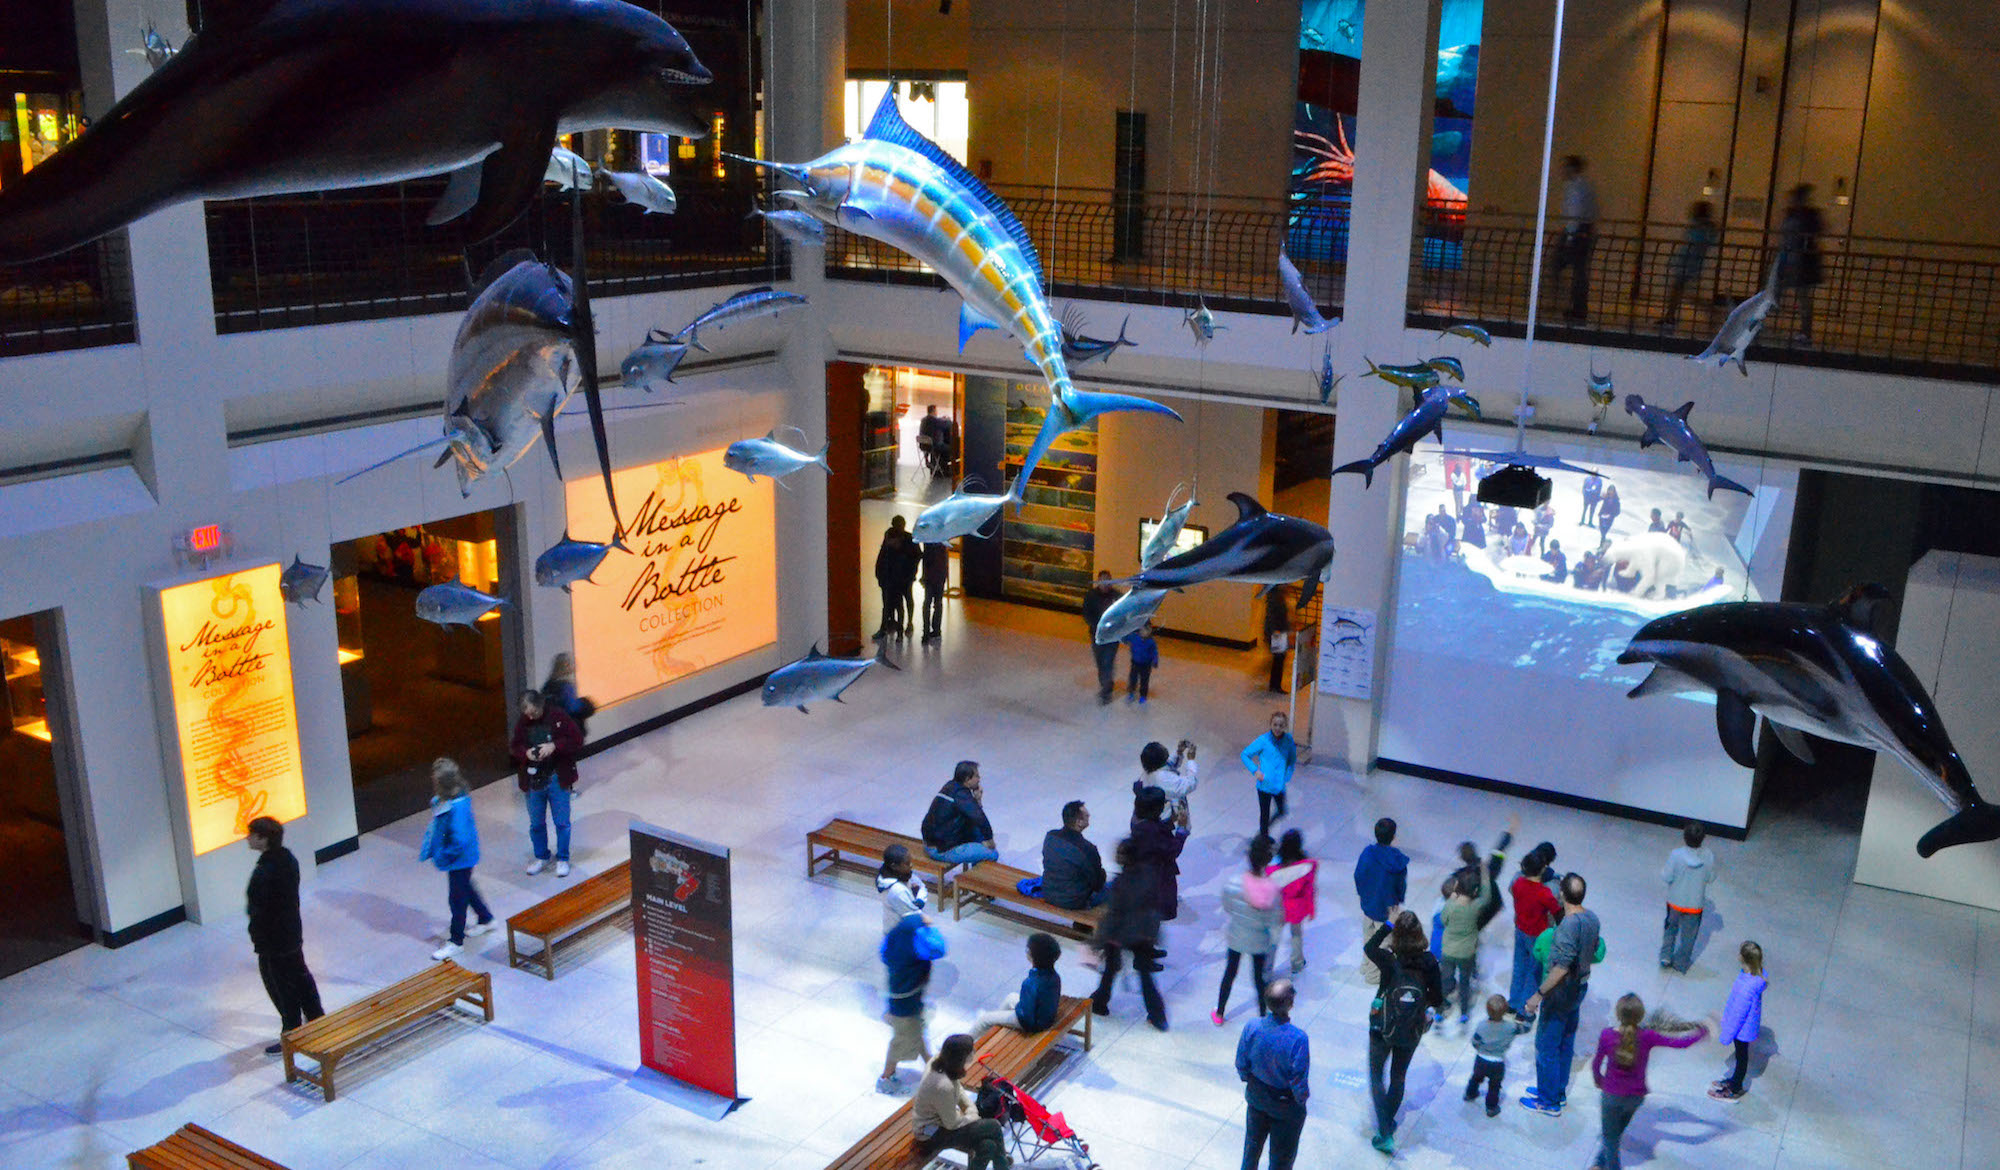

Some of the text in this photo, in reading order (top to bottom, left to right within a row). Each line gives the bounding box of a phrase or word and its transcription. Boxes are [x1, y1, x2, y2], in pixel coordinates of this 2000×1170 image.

[193, 525, 219, 550] EXIT
[619, 491, 742, 553] Message
[641, 535, 695, 557] in a
[621, 555, 738, 611] Bottle
[639, 594, 724, 632] COLLECTION
[180, 620, 276, 653] Message
[202, 642, 241, 658] in a
[190, 652, 274, 688] Bottle
[646, 893, 664, 905] MAIN
[665, 900, 688, 914] LEVEL
